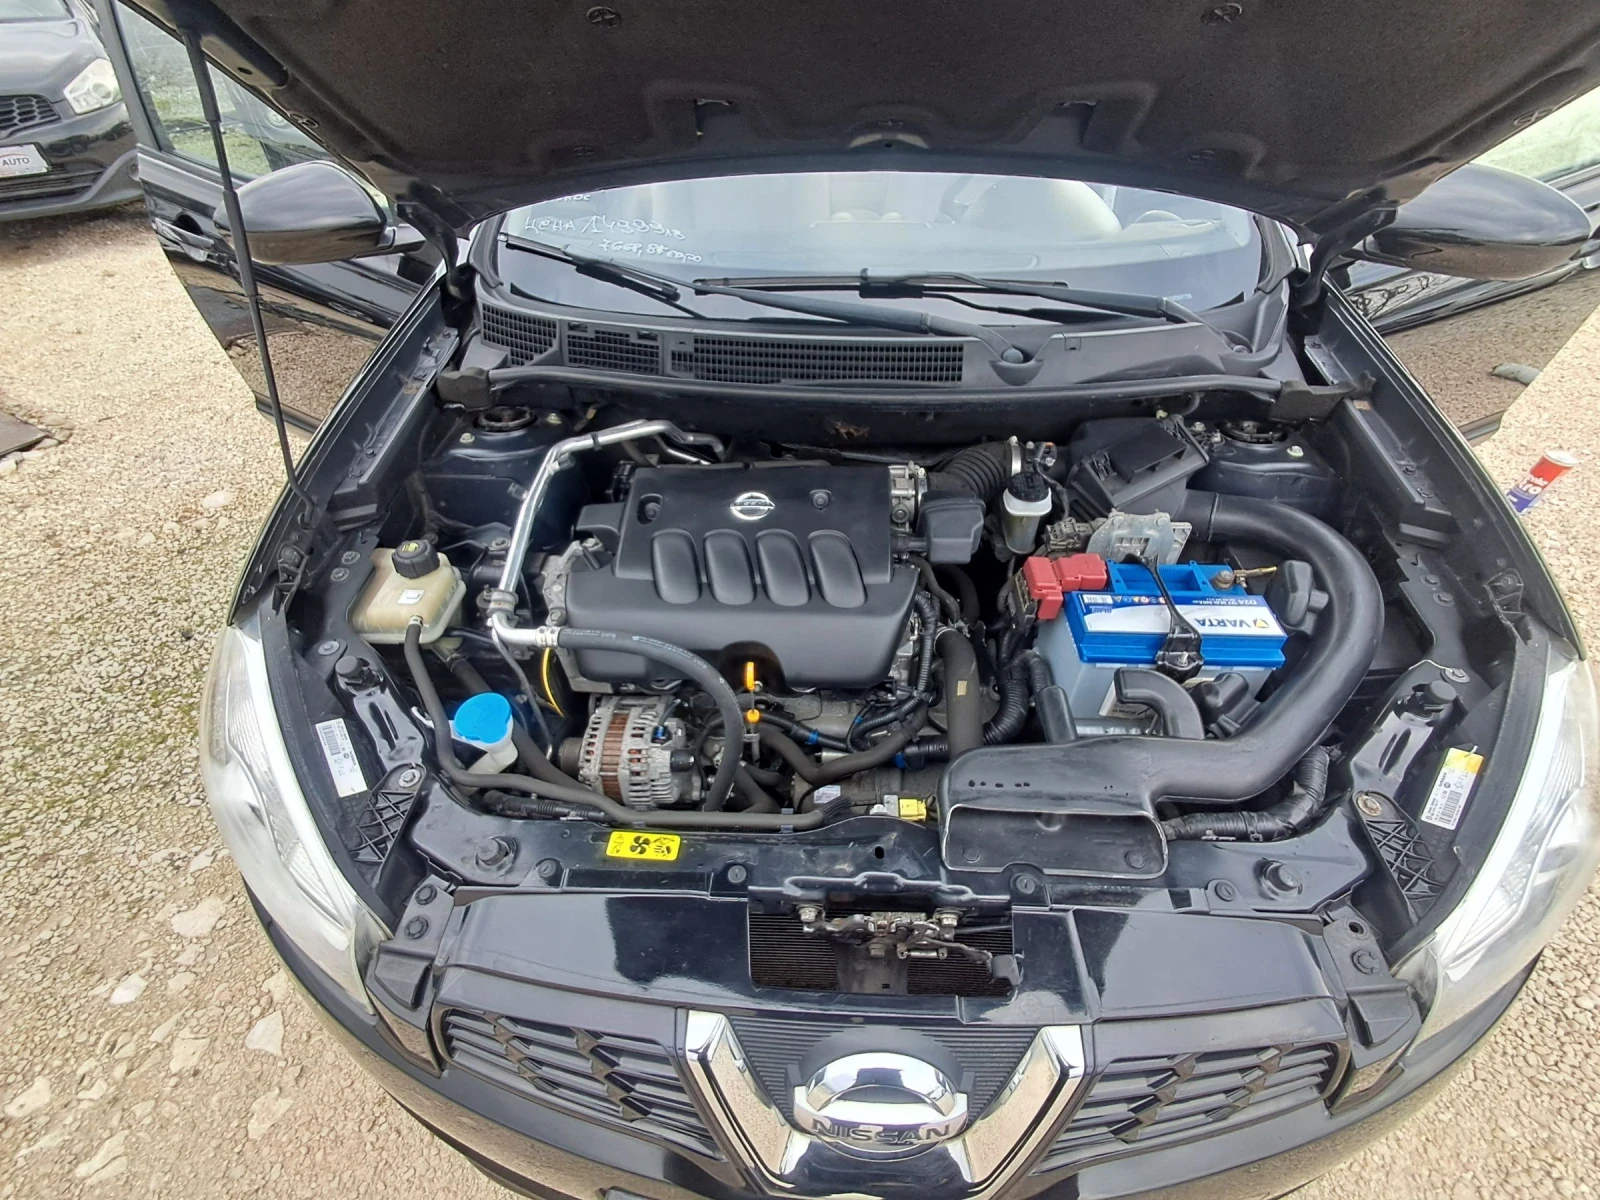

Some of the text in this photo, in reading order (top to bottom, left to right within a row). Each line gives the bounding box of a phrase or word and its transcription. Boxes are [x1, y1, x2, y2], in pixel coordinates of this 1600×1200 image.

[2, 157, 30, 166] AUTO
[1194, 618, 1252, 628] VARTA
[811, 1117, 951, 1145] NISSAN
